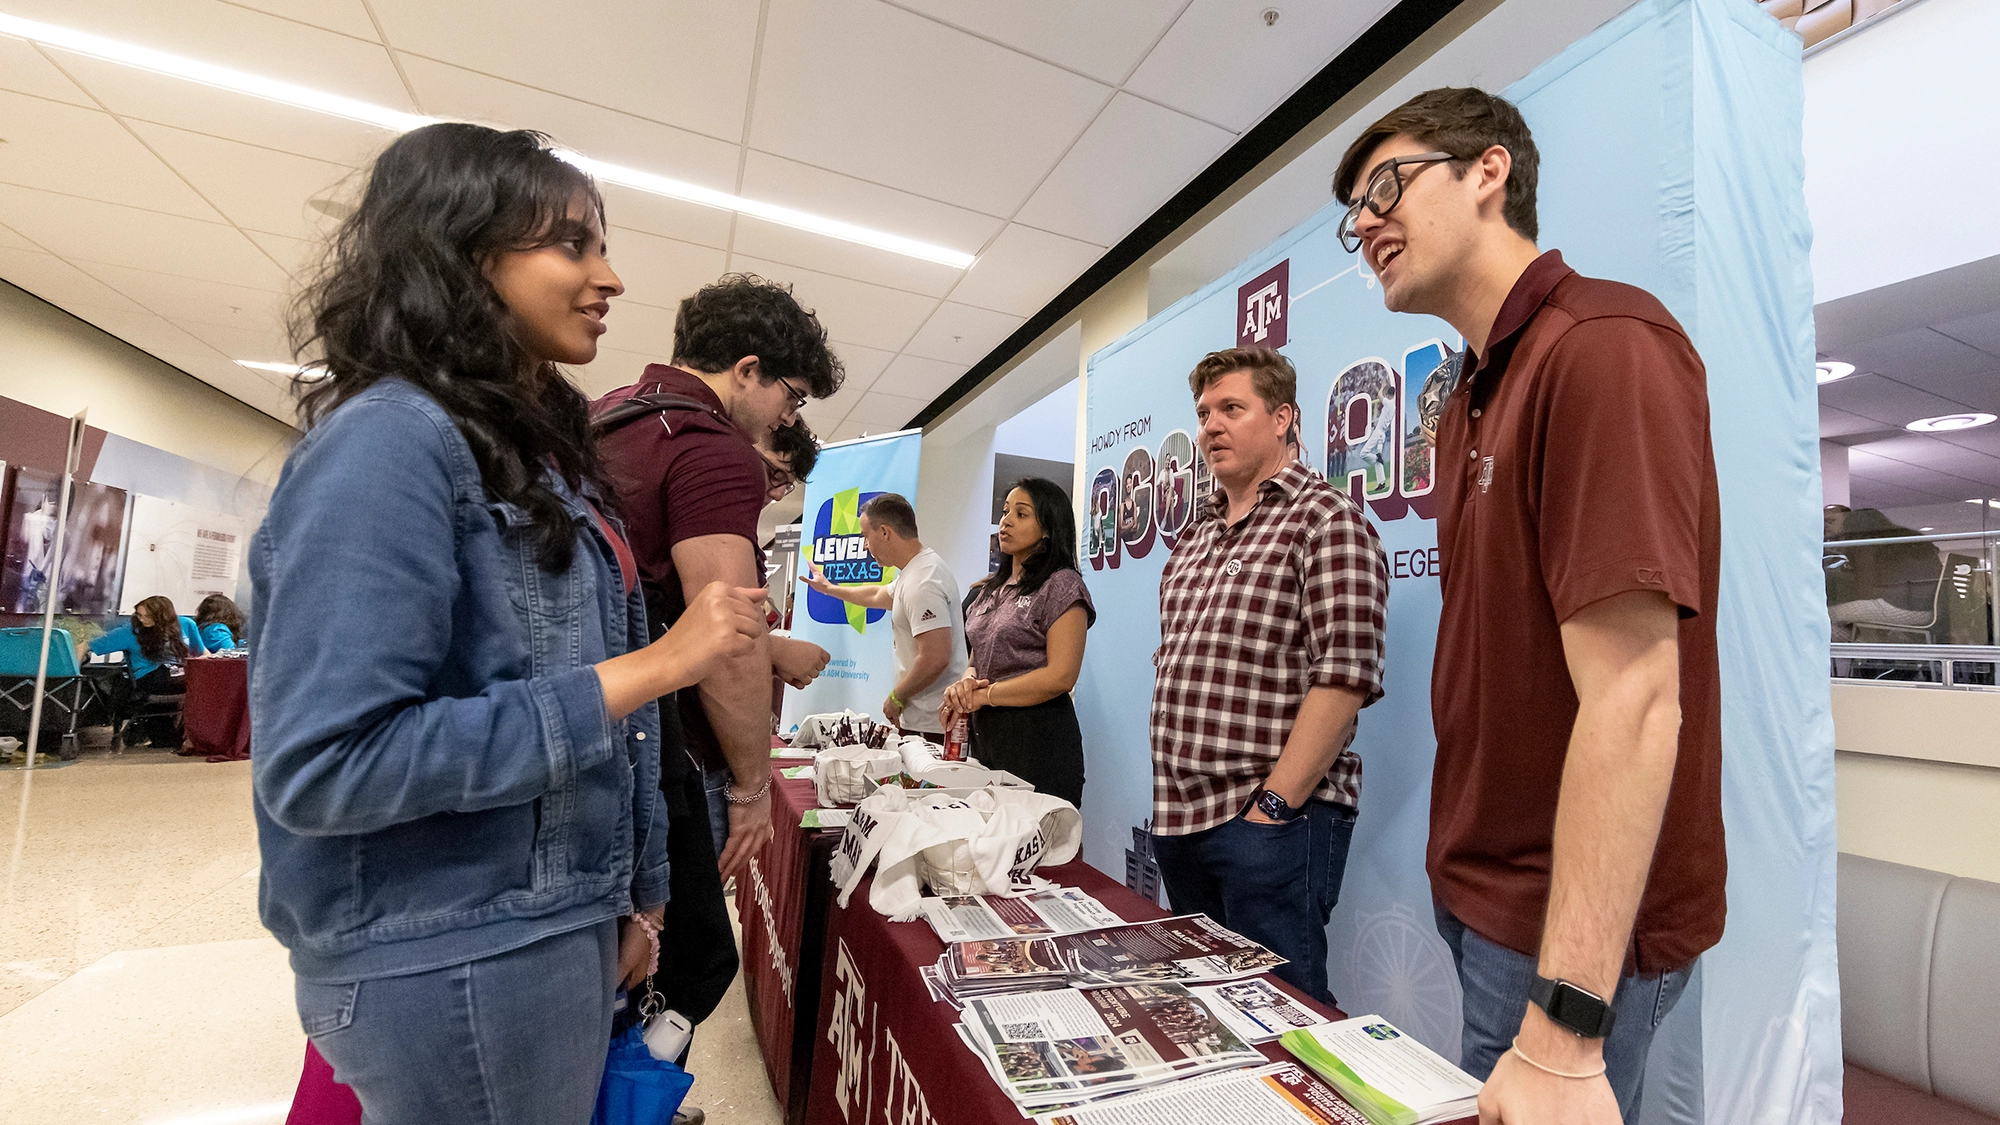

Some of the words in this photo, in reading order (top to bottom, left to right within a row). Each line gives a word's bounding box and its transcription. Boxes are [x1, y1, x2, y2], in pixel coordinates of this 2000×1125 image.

[1091, 427, 1121, 454] HOWDY
[1123, 415, 1151, 442] FROM
[814, 536, 868, 562] LEVEL
[825, 562, 881, 581] TEXAS
[850, 658, 857, 669] by
[840, 670, 870, 682] University
[1103, 1012, 1122, 1028] 2024
[1303, 1092, 1341, 1121] ATTENDING
